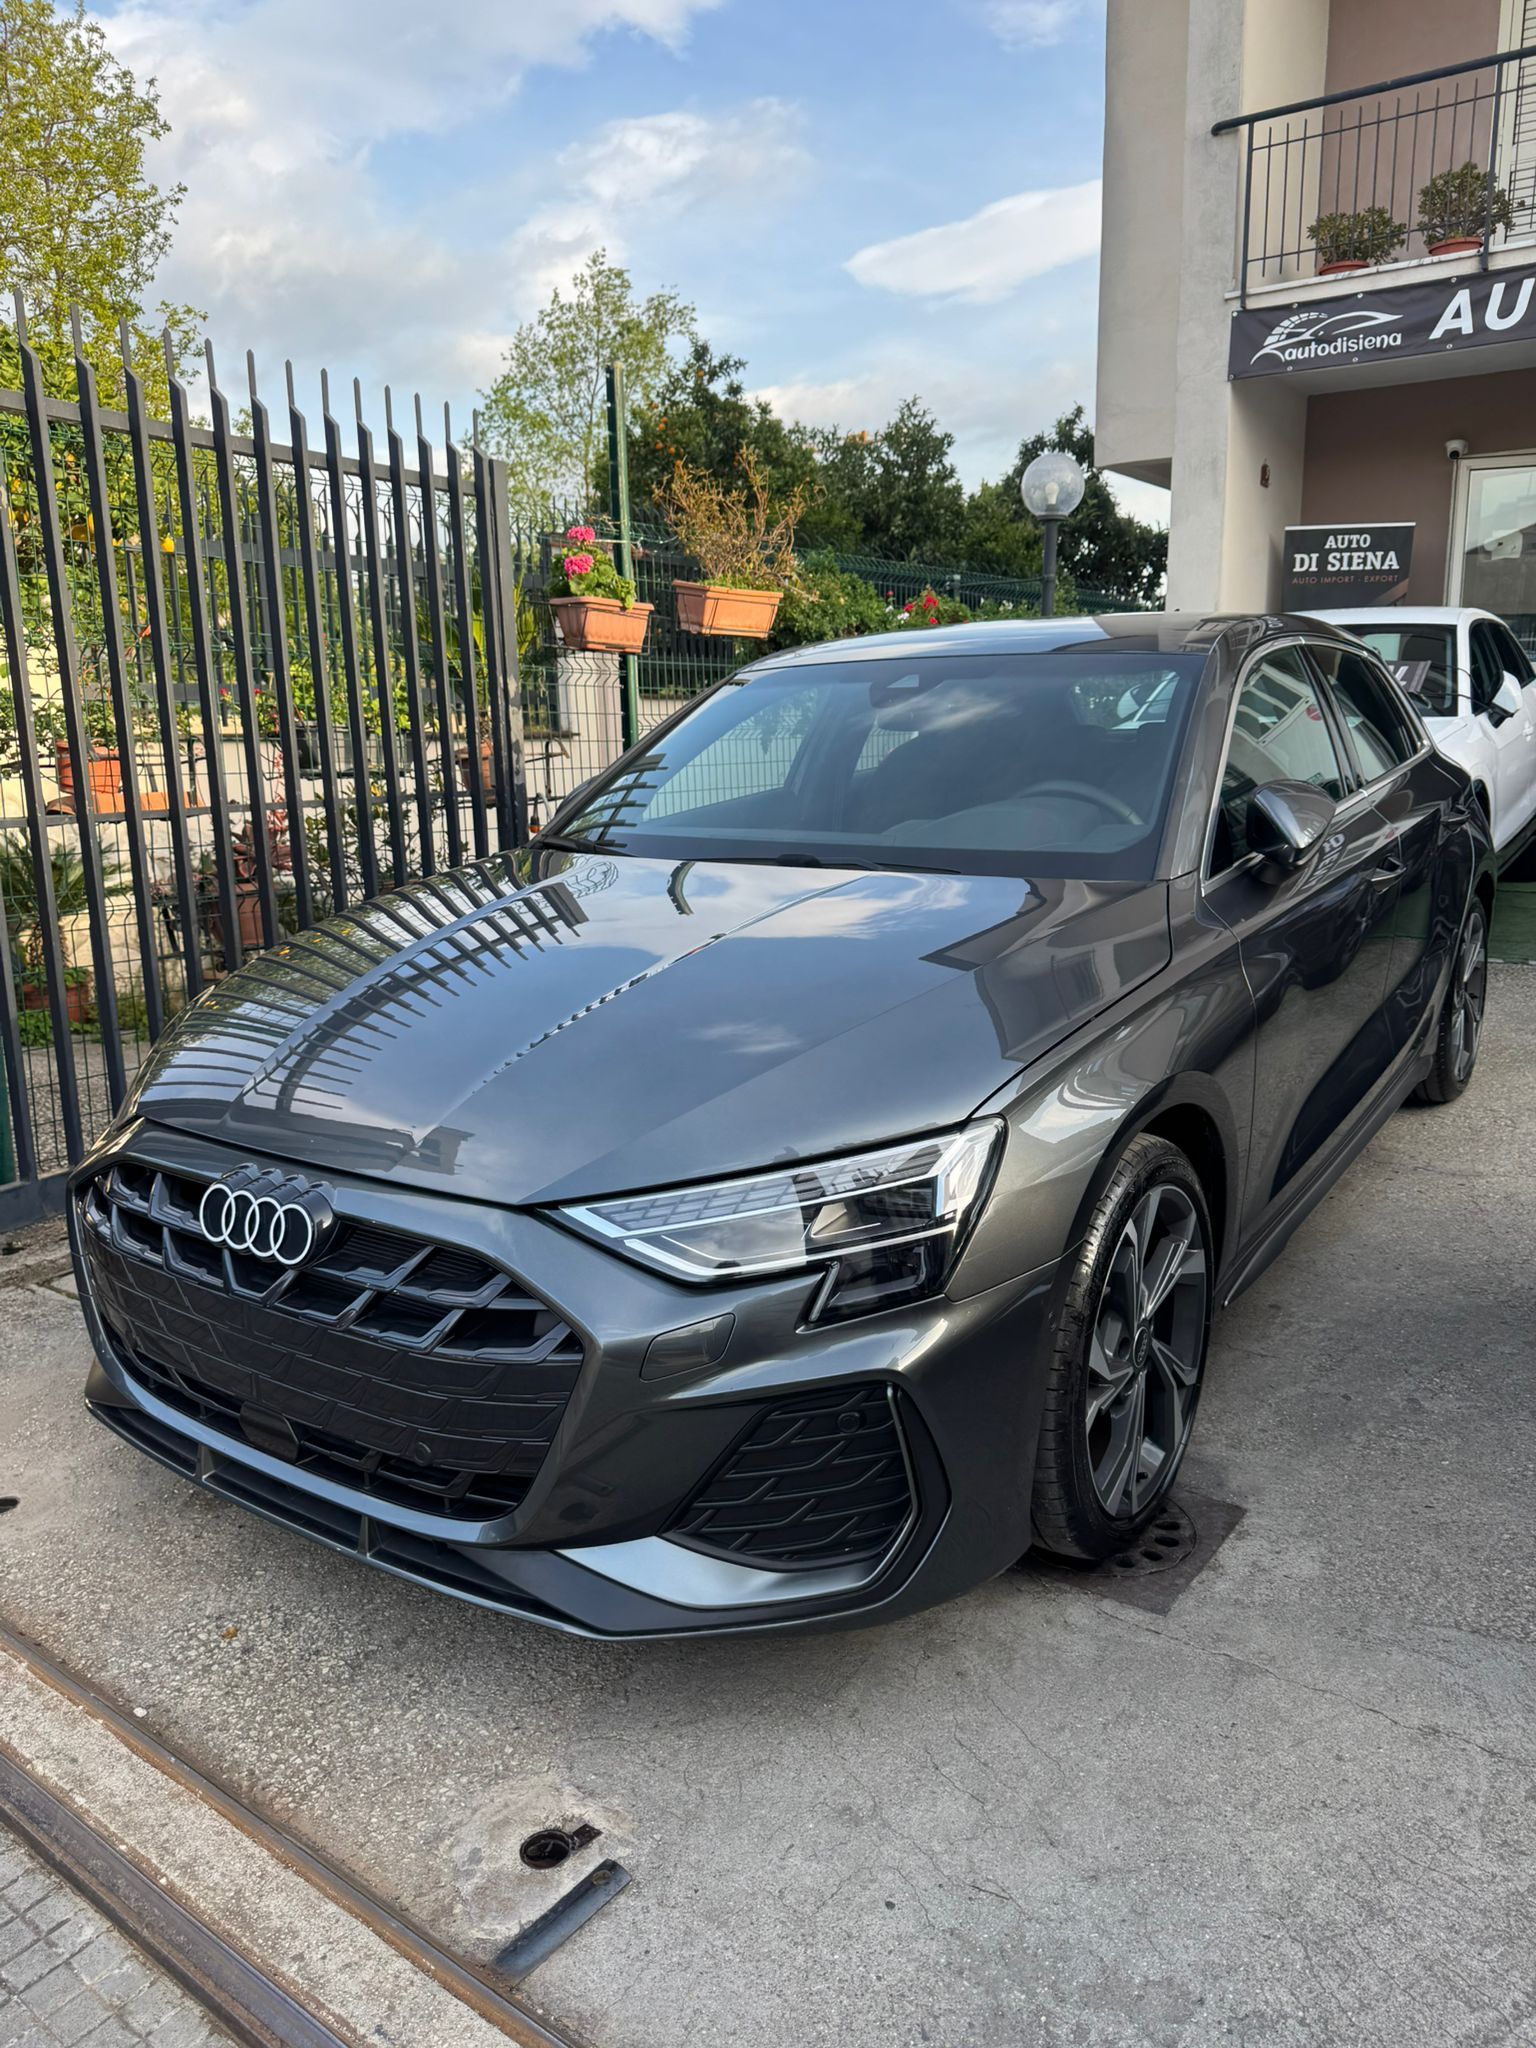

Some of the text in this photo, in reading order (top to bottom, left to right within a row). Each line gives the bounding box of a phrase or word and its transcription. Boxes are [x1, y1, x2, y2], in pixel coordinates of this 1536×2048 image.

[1428, 277, 1536, 340] AU
[1285, 331, 1402, 361] autodisiena
[1324, 533, 1371, 549] AUTO
[1292, 551, 1400, 572] DI SIENA
[1292, 577, 1318, 585] AUTO
[1320, 576, 1355, 584] IMPORT
[1364, 574, 1399, 583] EXPORT
